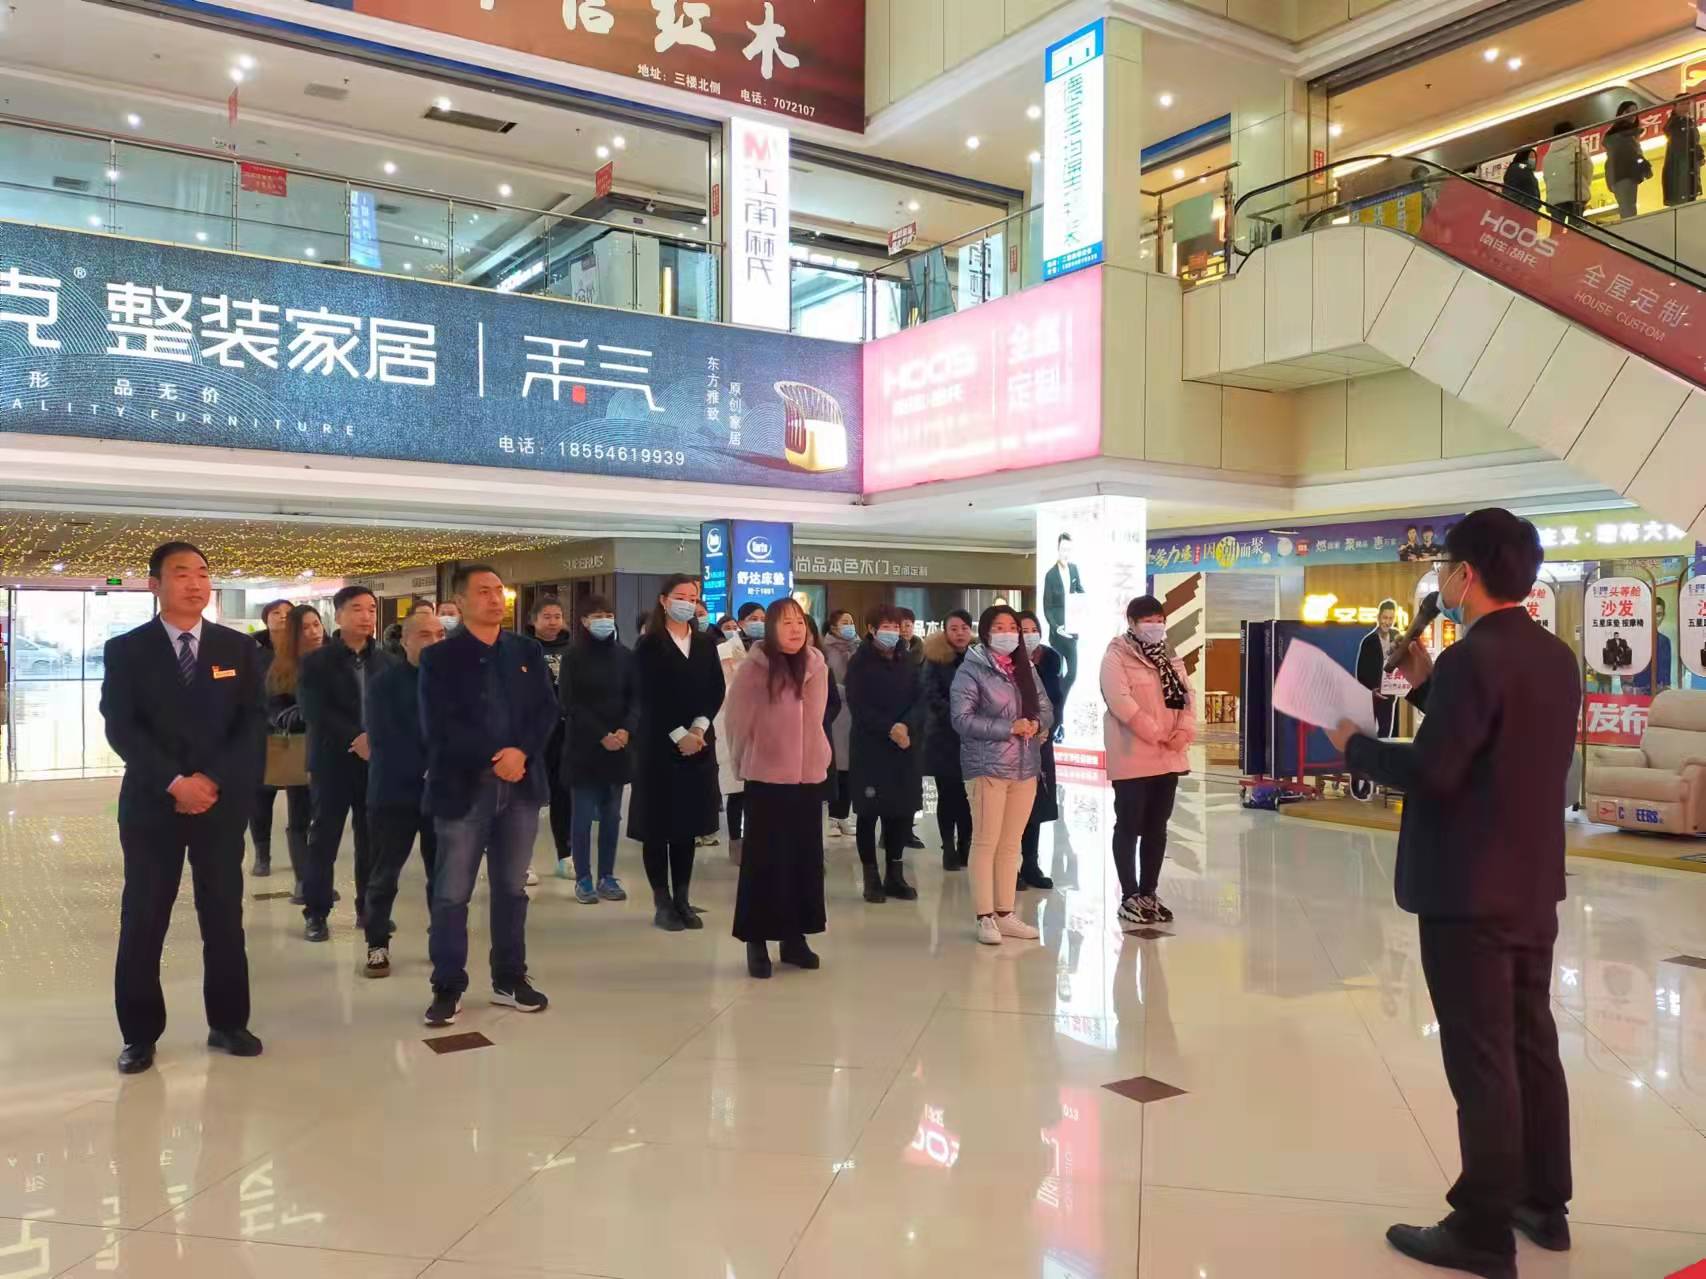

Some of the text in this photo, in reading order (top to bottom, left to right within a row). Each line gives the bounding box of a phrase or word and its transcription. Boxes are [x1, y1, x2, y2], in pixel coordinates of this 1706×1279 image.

[740, 89, 816, 118] 电话：7072107
[1479, 209, 1559, 257] HOOS
[1583, 264, 1690, 328] 全屋定制
[106, 282, 437, 386] 整装家居
[1574, 291, 1665, 341] HOUSE CUSTOM
[706, 356, 720, 422] 东方雅致
[151, 409, 354, 436] FURNITURE
[728, 381, 742, 446] 原创家居
[795, 556, 928, 577] 尚品本色木门 空间定制
[1601, 600, 1633, 617] 沙发
[1609, 586, 1641, 597] 头等舱
[1592, 618, 1644, 628] 五星床垫 按摩椅
